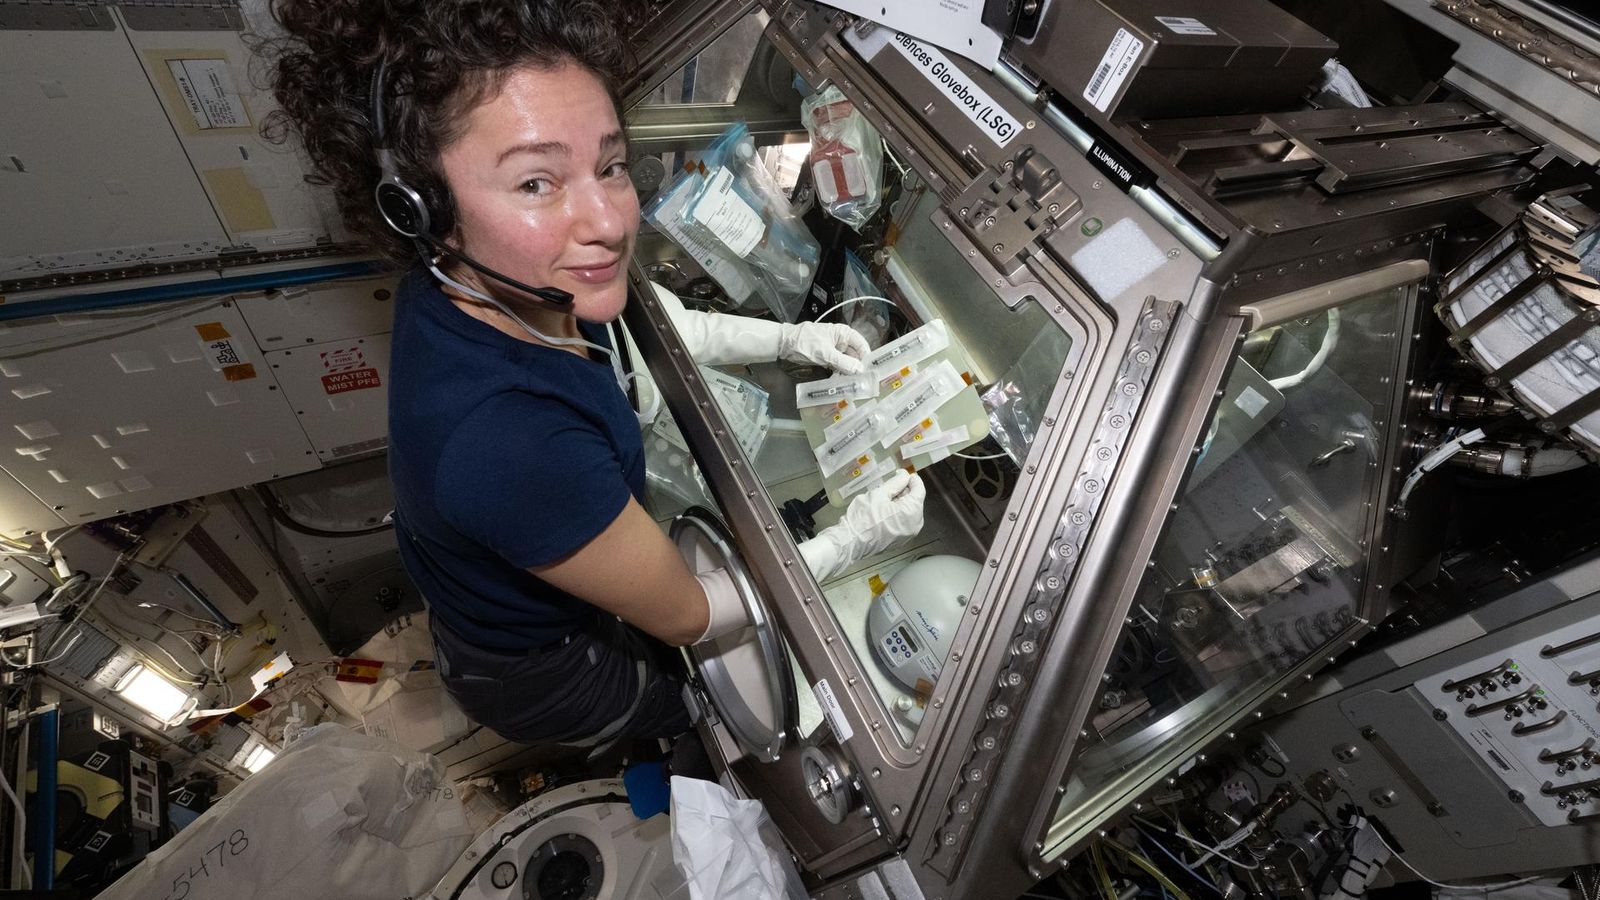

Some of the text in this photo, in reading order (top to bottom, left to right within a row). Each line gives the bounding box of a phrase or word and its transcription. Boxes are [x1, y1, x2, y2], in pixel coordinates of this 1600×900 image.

[1131, 41, 1141, 56] Fan
[930, 61, 981, 112] Glovebox
[975, 105, 1016, 144] (LSG)
[1093, 147, 1132, 183] ILLUMINATION
[328, 381, 355, 391] MIST
[329, 371, 371, 382] WATER
[819, 681, 829, 694] Main
[826, 694, 836, 709] Door
